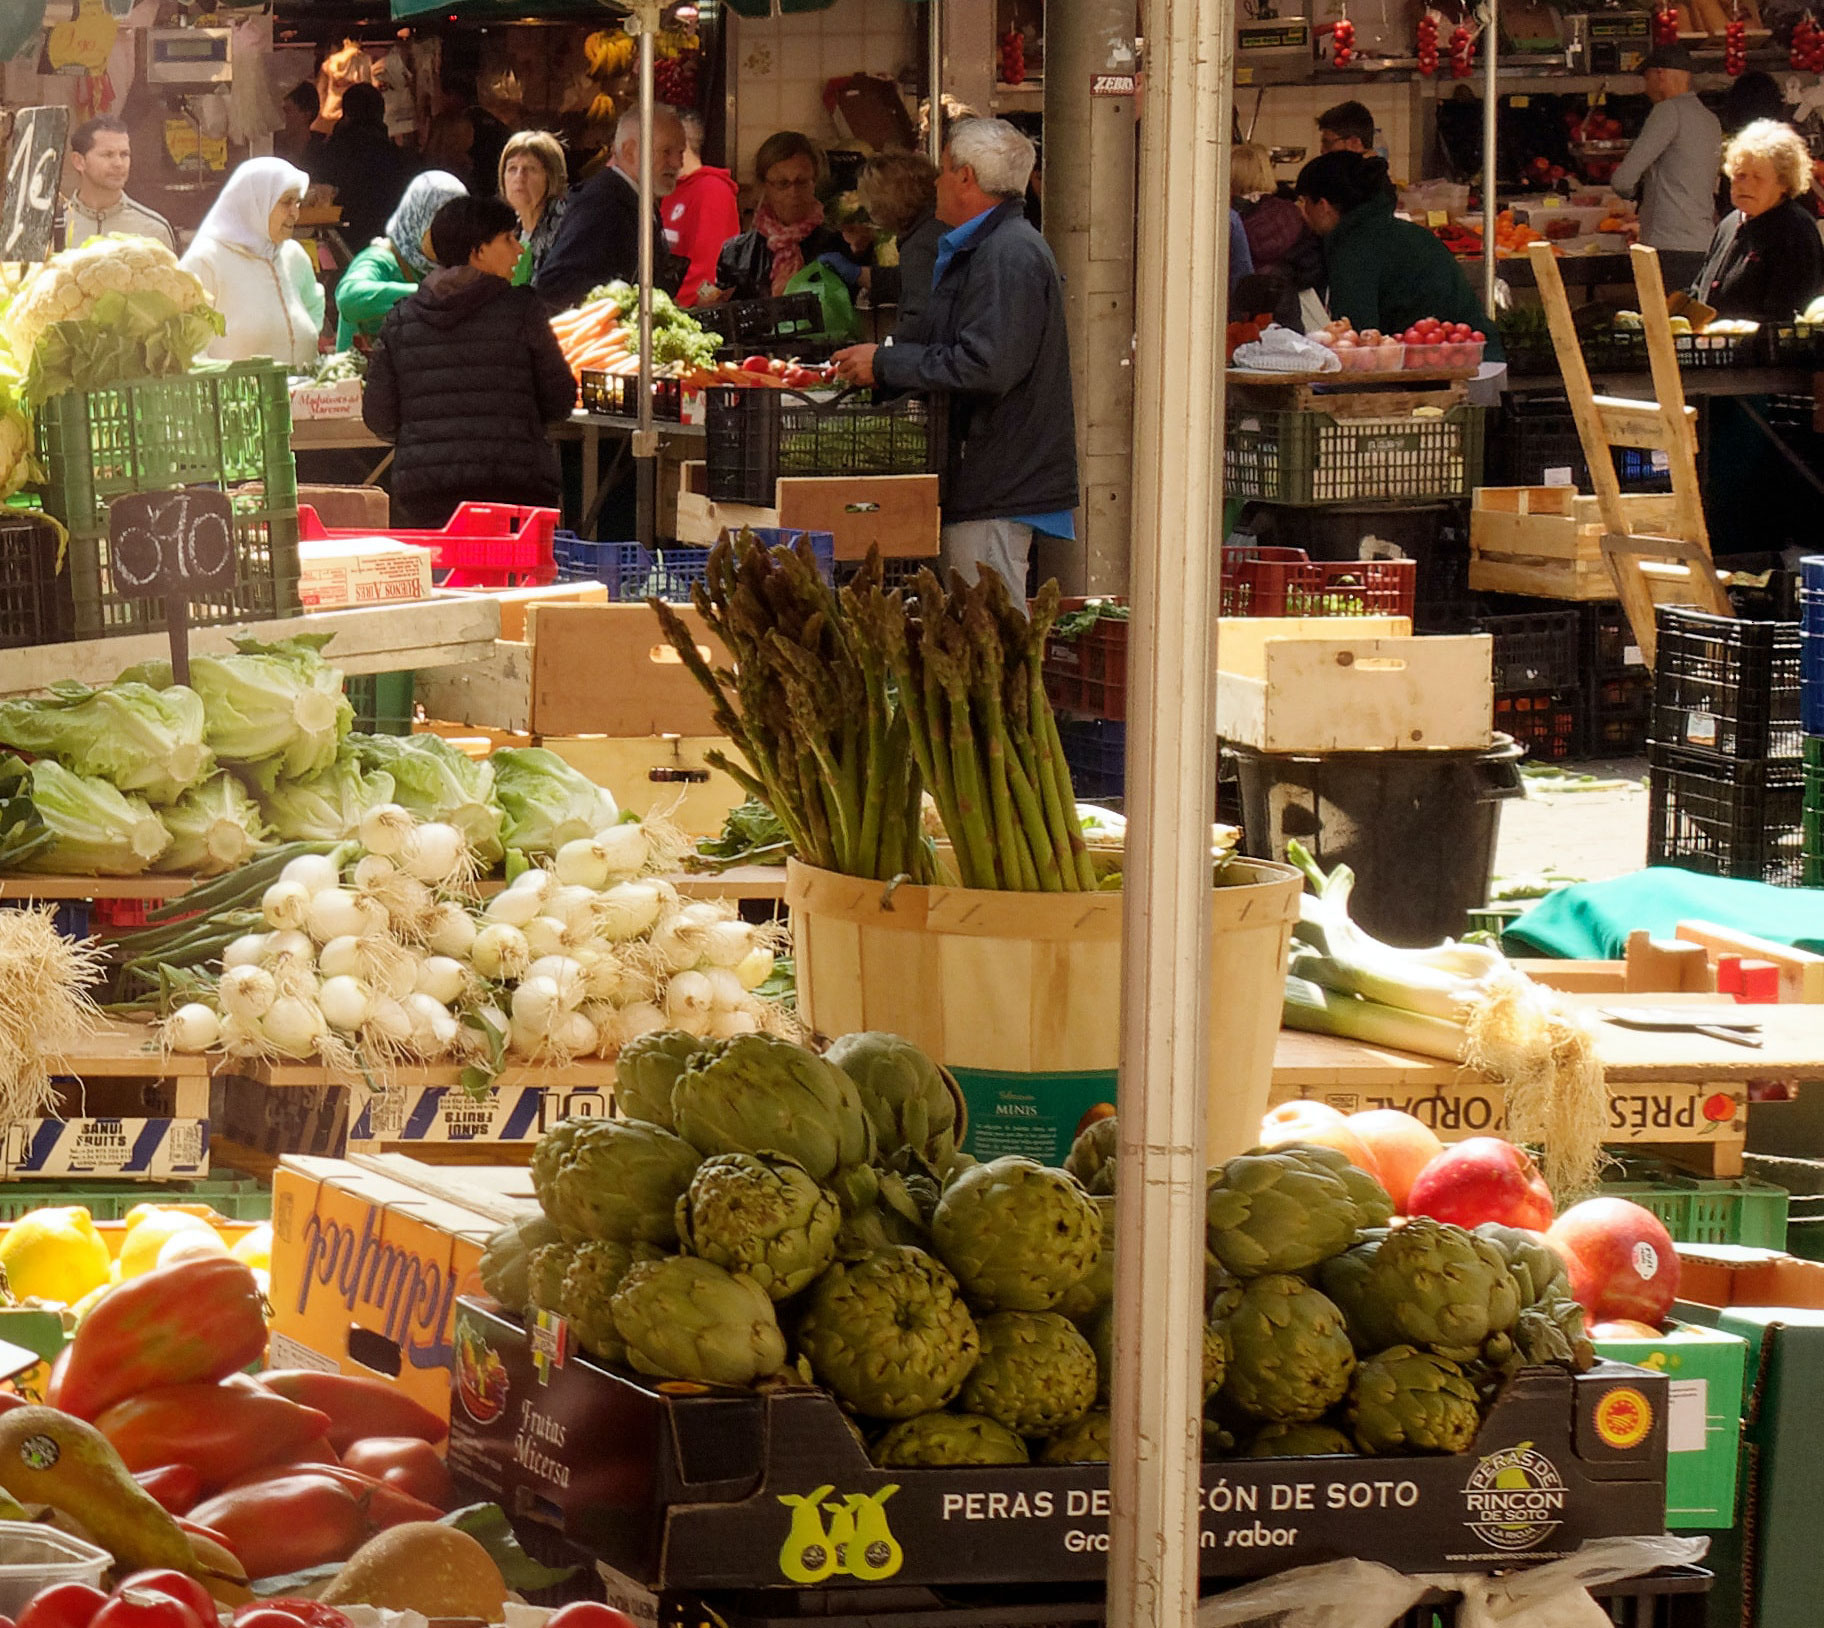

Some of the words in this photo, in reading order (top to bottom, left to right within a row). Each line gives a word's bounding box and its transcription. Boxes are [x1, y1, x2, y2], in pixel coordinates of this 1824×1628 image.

[445, 1111, 493, 1122] FRUITS
[995, 1104, 1038, 1115] MINIS
[1609, 1095, 1697, 1137] PRÉS
[81, 1123, 123, 1134] SANUI
[448, 1122, 489, 1135] SANUI
[76, 1135, 127, 1147] FRUITS
[521, 1399, 567, 1448] Frutas
[512, 1430, 571, 1489] Micersa
[1472, 1451, 1534, 1489] PERAS
[1533, 1461, 1558, 1488] DE
[942, 1491, 1053, 1521] PERAS
[1066, 1489, 1110, 1517] DE
[1271, 1484, 1316, 1511] DE
[1326, 1481, 1419, 1508] SOTO
[1480, 1511, 1503, 1521] DE
[1504, 1509, 1549, 1521] SOTO
[1063, 1528, 1110, 1553] Gra
[1223, 1520, 1299, 1548] sabor
